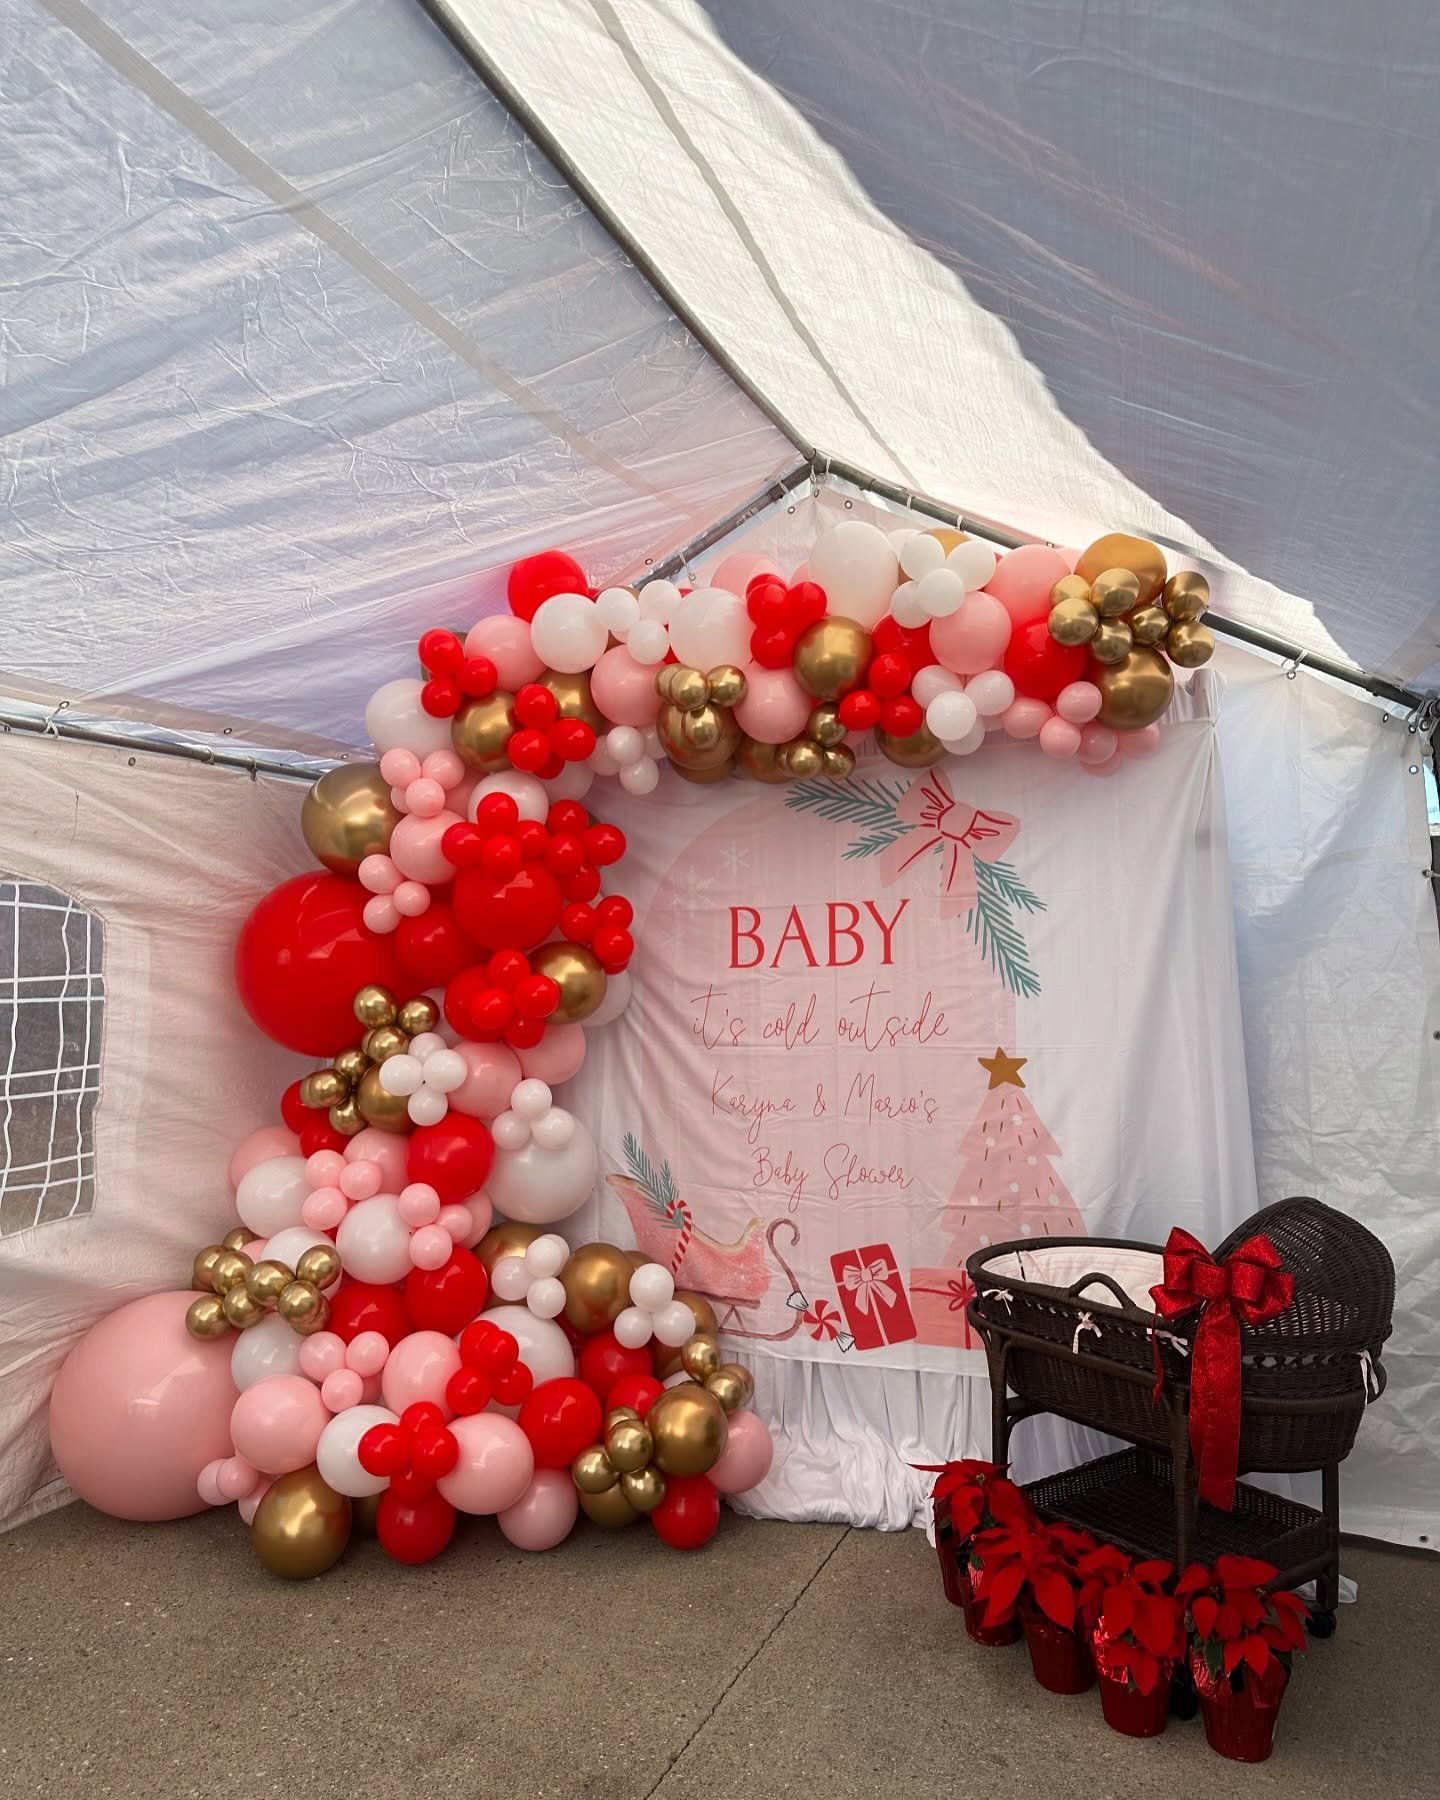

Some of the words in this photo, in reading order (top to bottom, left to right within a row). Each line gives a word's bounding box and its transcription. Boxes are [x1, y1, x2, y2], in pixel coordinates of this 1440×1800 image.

[728, 899, 910, 968] BABY
[690, 983, 746, 1050] it's
[762, 993, 820, 1050] cold
[837, 981, 949, 1051] outside
[711, 1070, 796, 1144] Karyna
[813, 1083, 827, 1117] &
[844, 1072, 939, 1125] Mario's
[751, 1146, 809, 1213] Baby
[823, 1143, 914, 1200] Shower
